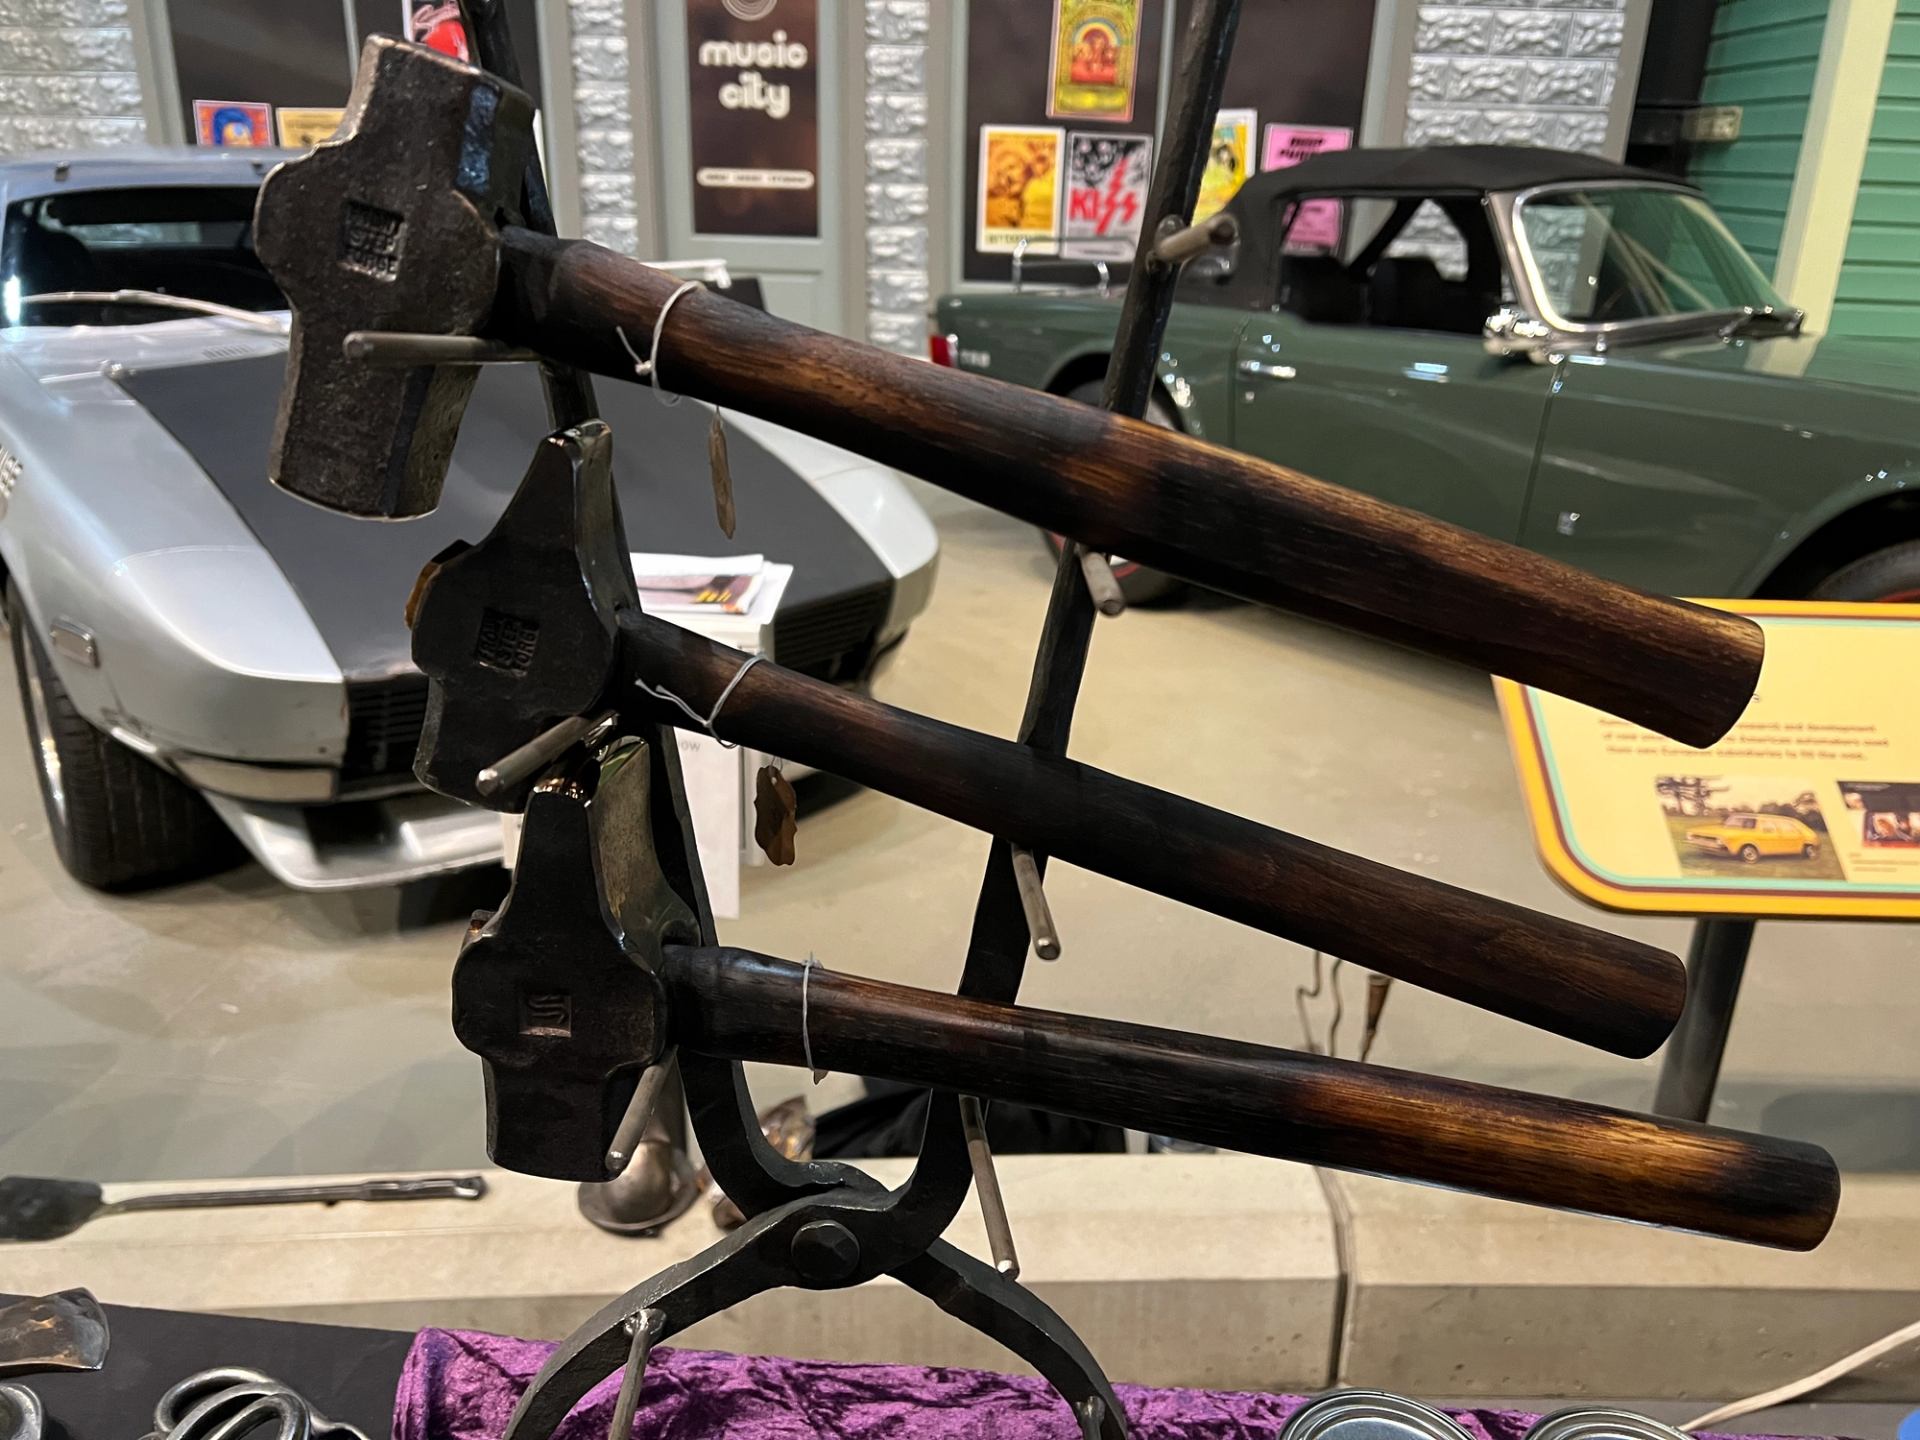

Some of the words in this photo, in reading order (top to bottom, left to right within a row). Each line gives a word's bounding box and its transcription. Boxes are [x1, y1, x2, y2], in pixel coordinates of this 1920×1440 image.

[699, 29, 808, 68] music
[718, 71, 790, 119] city
[1068, 158, 1140, 236] KISS
